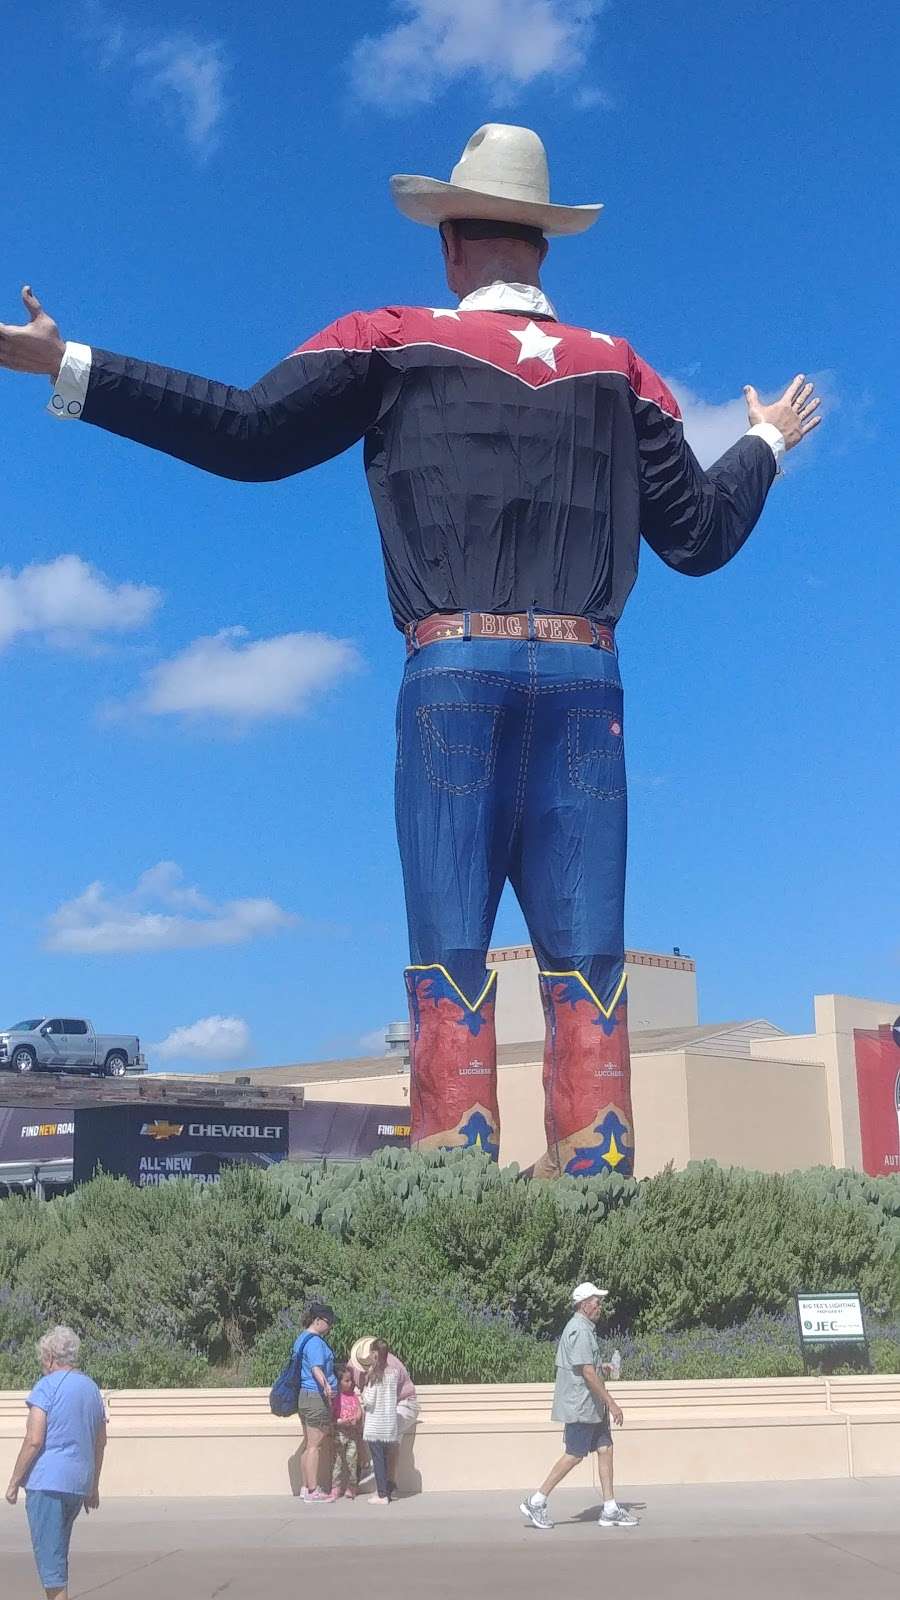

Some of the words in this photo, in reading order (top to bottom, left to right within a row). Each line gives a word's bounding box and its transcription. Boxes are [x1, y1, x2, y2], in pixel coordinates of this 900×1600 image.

[480, 613, 522, 636] BIG
[535, 618, 578, 640] TEX
[21, 1125, 39, 1137] FIND
[39, 1123, 57, 1136] NEW
[188, 1123, 283, 1139] CHEVROLET
[377, 1124, 394, 1135] FIND
[394, 1125, 411, 1137] NEW
[139, 1157, 192, 1171] ALL-NEW
[814, 1321, 839, 1331] JEC
